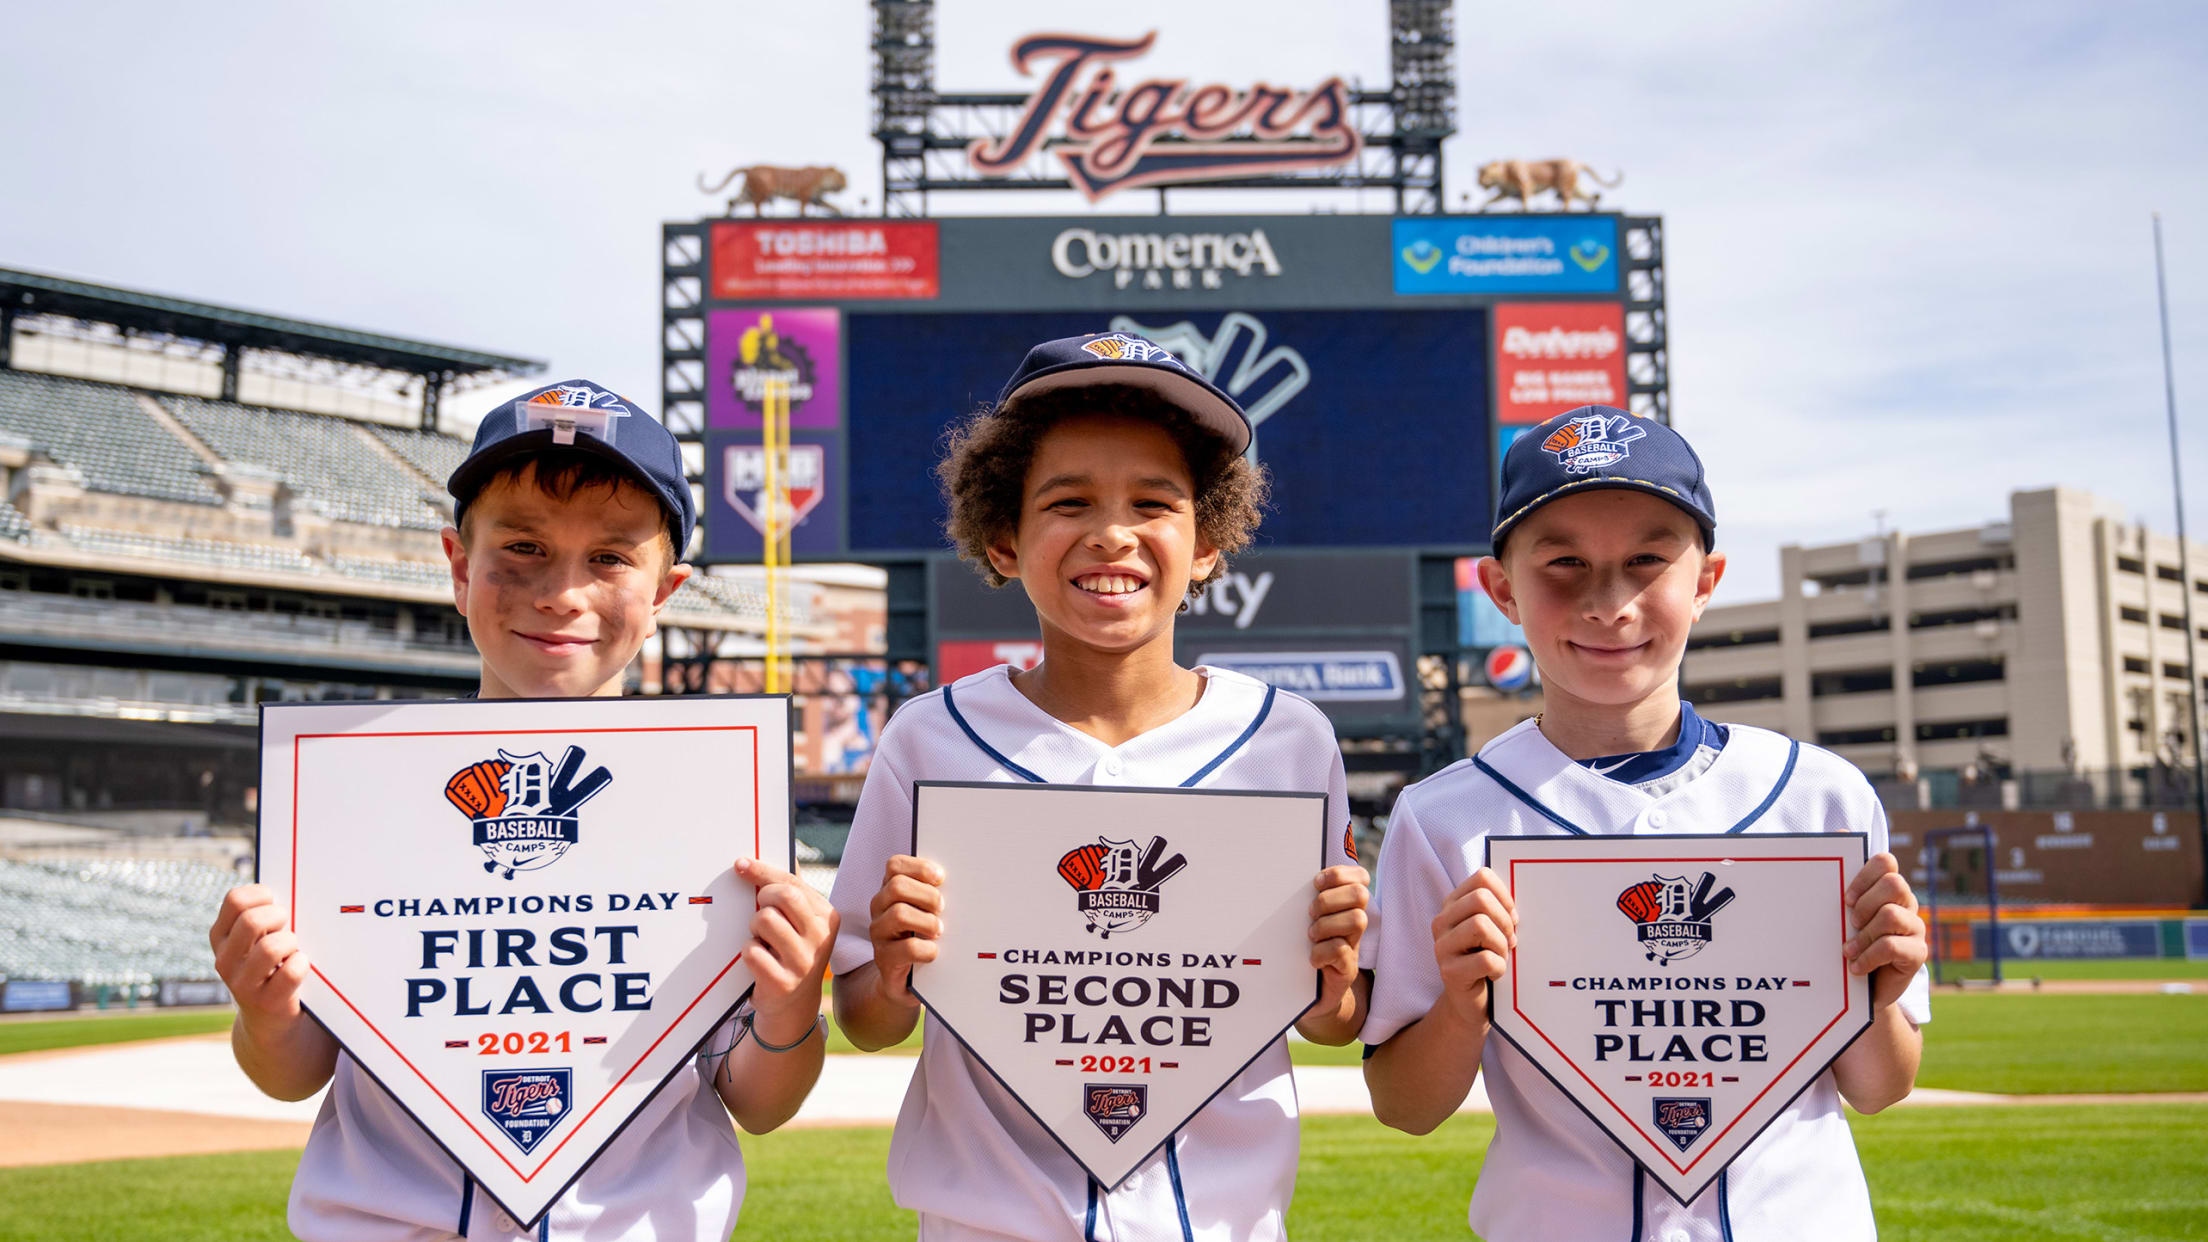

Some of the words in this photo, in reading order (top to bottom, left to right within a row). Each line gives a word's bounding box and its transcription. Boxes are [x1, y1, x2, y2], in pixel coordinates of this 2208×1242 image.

[969, 29, 1361, 203] Tigers
[755, 230, 887, 256] TOSHIBA
[1448, 255, 1565, 277] Foundation
[1114, 269, 1223, 290] PARK
[1567, 443, 1618, 458] BASEBALL
[486, 820, 565, 840] BASEBALL
[505, 842, 547, 853] CAMPS
[373, 894, 594, 918] CHAMPIONS
[608, 892, 681, 912] DAY
[1088, 893, 1149, 909] BASEBALL
[1103, 909, 1135, 919] CAMPS
[1646, 924, 1702, 938] BASEBALL
[419, 925, 640, 970] FIRST
[1660, 939, 1690, 948] CAMPS
[1003, 949, 1172, 967] CHAMPIONS
[1181, 953, 1239, 969] DAY
[999, 974, 1241, 1009] SECOND
[1572, 976, 1727, 991] CHAMPIONS
[1735, 977, 1788, 991] DAY
[404, 972, 654, 1018] PLACE
[1594, 999, 1766, 1027] THIRD
[1023, 1012, 1213, 1047] PLACE
[477, 1031, 573, 1056] 2021
[1593, 1033, 1769, 1062] PLACE
[1080, 1055, 1153, 1074] 2021
[522, 1075, 552, 1083] DETROIT
[1647, 1071, 1715, 1088] 2021
[491, 1075, 561, 1117] Tigers
[1090, 1088, 1139, 1117] Tigers
[504, 1119, 551, 1129] FOUNDATION
[1659, 1102, 1704, 1128] Tigers
